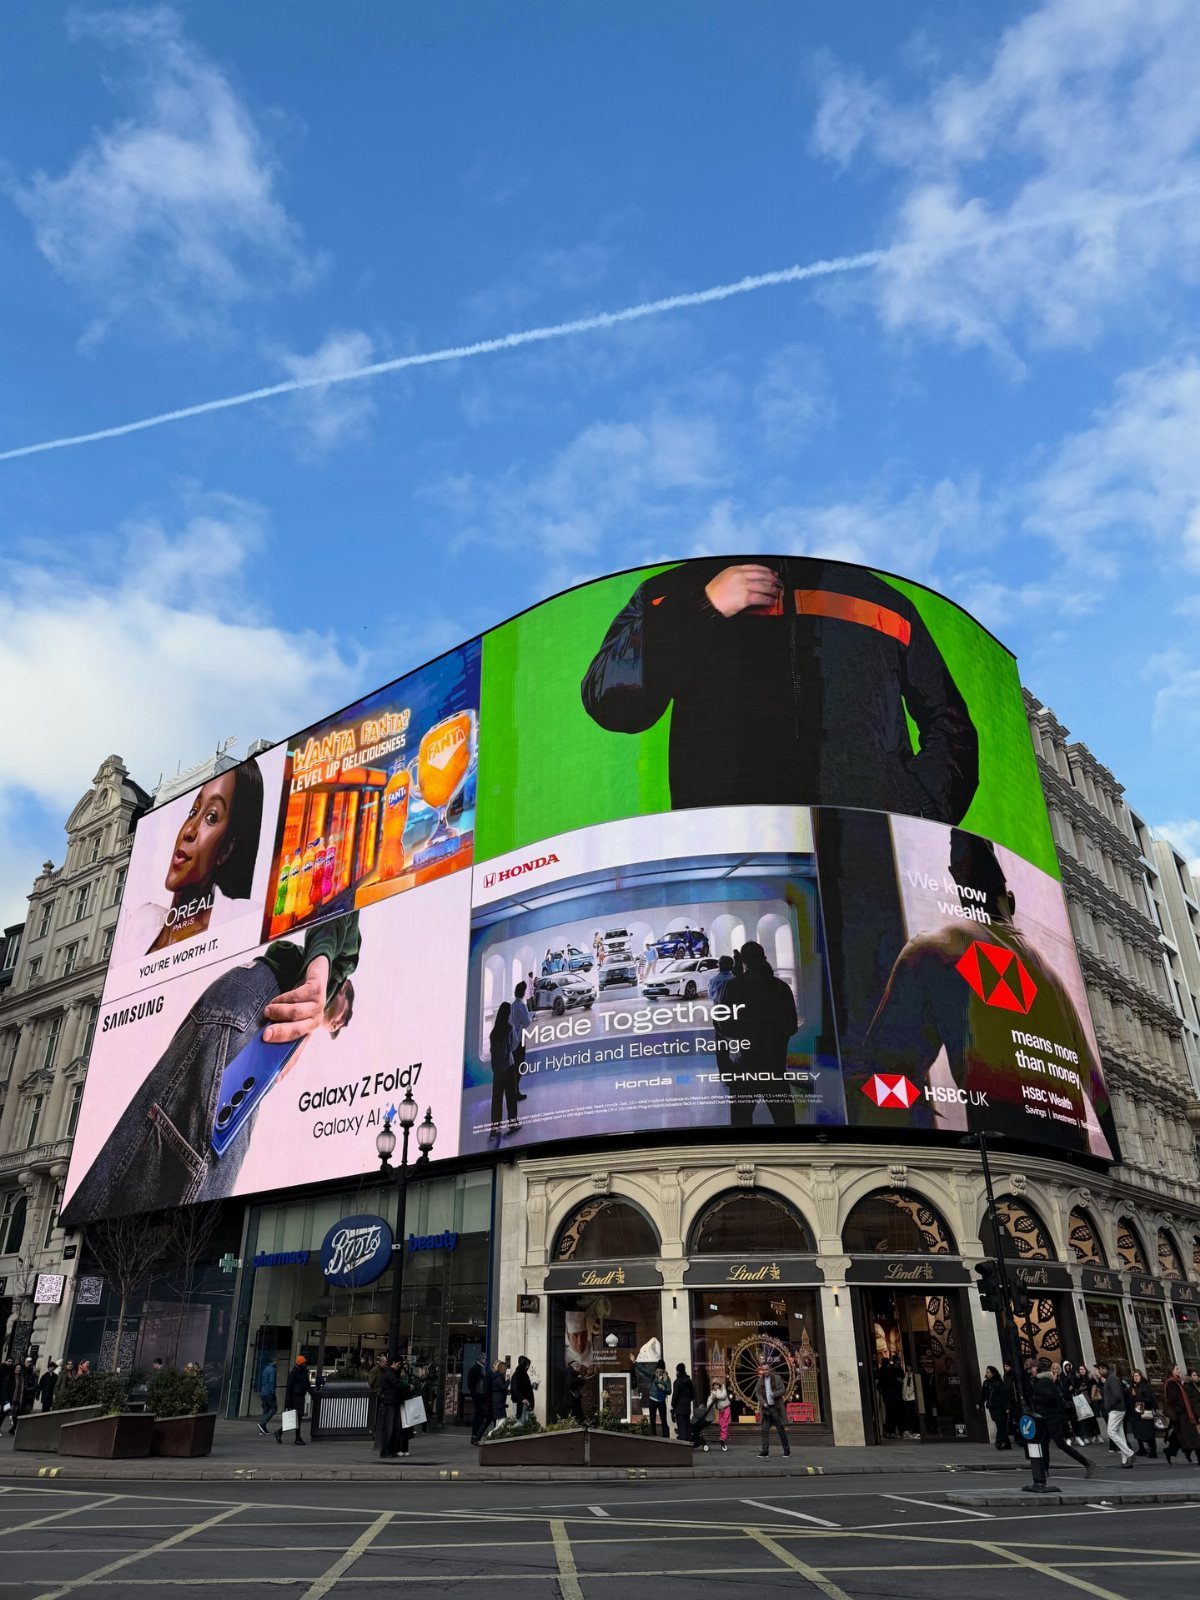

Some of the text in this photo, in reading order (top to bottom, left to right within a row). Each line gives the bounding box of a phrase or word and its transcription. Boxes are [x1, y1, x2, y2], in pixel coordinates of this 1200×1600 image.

[292, 708, 411, 774] WANTA FANTA?
[427, 726, 466, 764] FANTA
[290, 734, 406, 795] LEVEL UP DELICIOUSNESS
[498, 853, 560, 882] HONDA
[906, 870, 986, 903] We know
[172, 917, 195, 932] PARIS
[937, 901, 991, 925] wealth
[139, 938, 219, 978] YOU'RE WORTH IT.
[102, 995, 164, 1033] SAMSUNG
[521, 1002, 745, 1047] Made Together
[518, 1037, 751, 1075] Our Hybrid and Electric Range
[1011, 1029, 1079, 1065] means more
[615, 1077, 672, 1090] Honda
[696, 1072, 821, 1084] TECHNOLOGY
[1015, 1050, 1080, 1090] than money
[298, 1062, 422, 1112] Galaxy Z Fold7
[924, 1085, 989, 1107] HSBC UK
[1021, 1085, 1073, 1111] HSBC Wealth
[313, 1108, 380, 1139] Galaxy AI
[1024, 1104, 1047, 1120] Savings
[324, 1224, 382, 1276] Boots
[408, 1229, 459, 1252] beauty
[253, 1250, 311, 1269] pharmacy
[726, 1264, 770, 1281] Lindt
[884, 1263, 925, 1280] Lindt
[578, 1269, 616, 1286] Lindt
